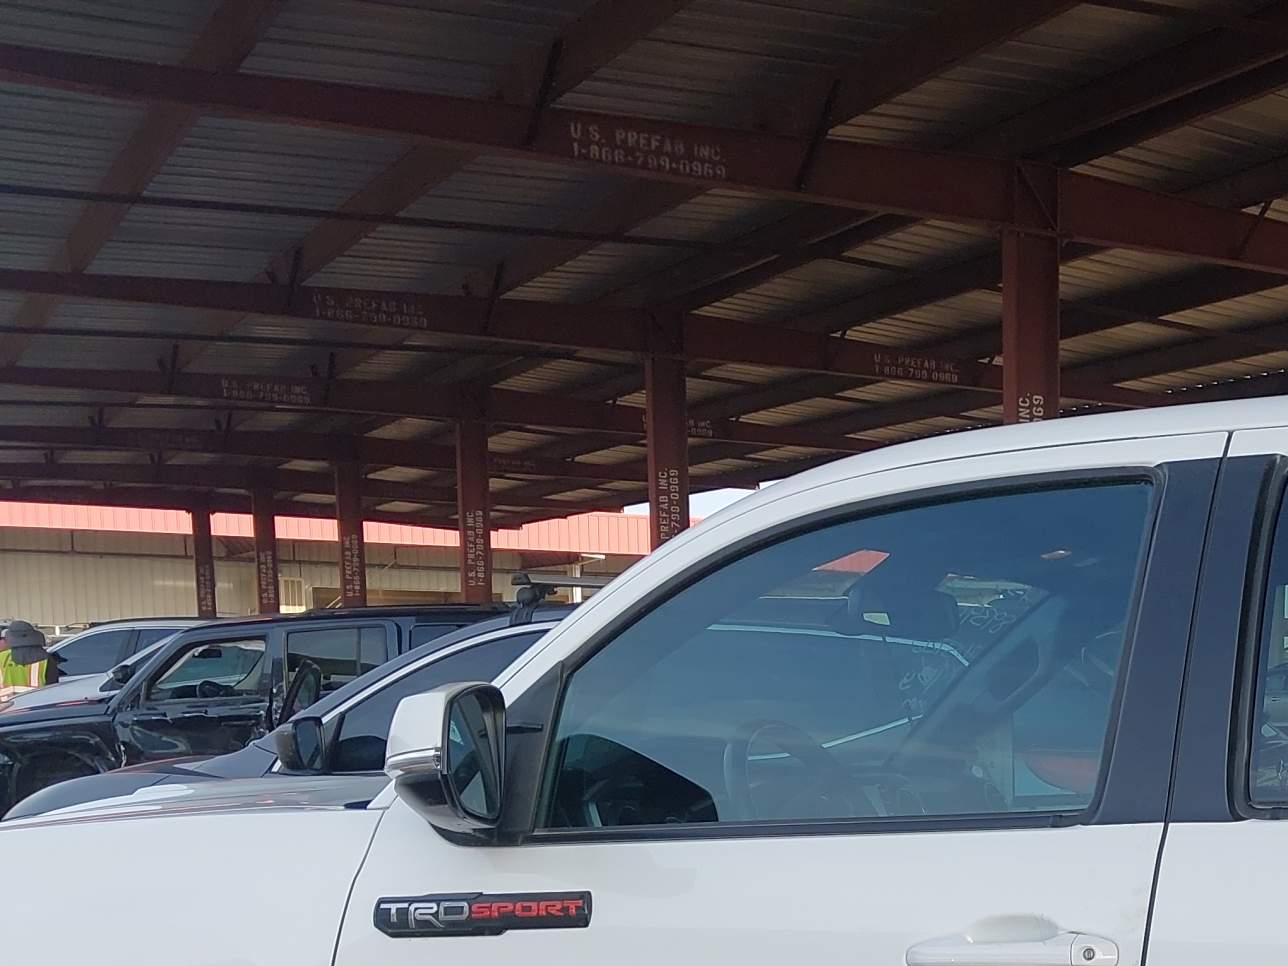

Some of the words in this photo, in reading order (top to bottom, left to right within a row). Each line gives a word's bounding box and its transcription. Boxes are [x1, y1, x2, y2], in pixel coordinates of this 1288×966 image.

[572, 141, 729, 179] 1-866-799-0969
[615, 128, 685, 156] PREFAB
[694, 143, 728, 162] INC.
[658, 467, 669, 490] INC.
[659, 495, 670, 540] PREFAB
[467, 530, 476, 565] PREFAB
[380, 901, 469, 928] TRD
[471, 900, 583, 918] SPORT
